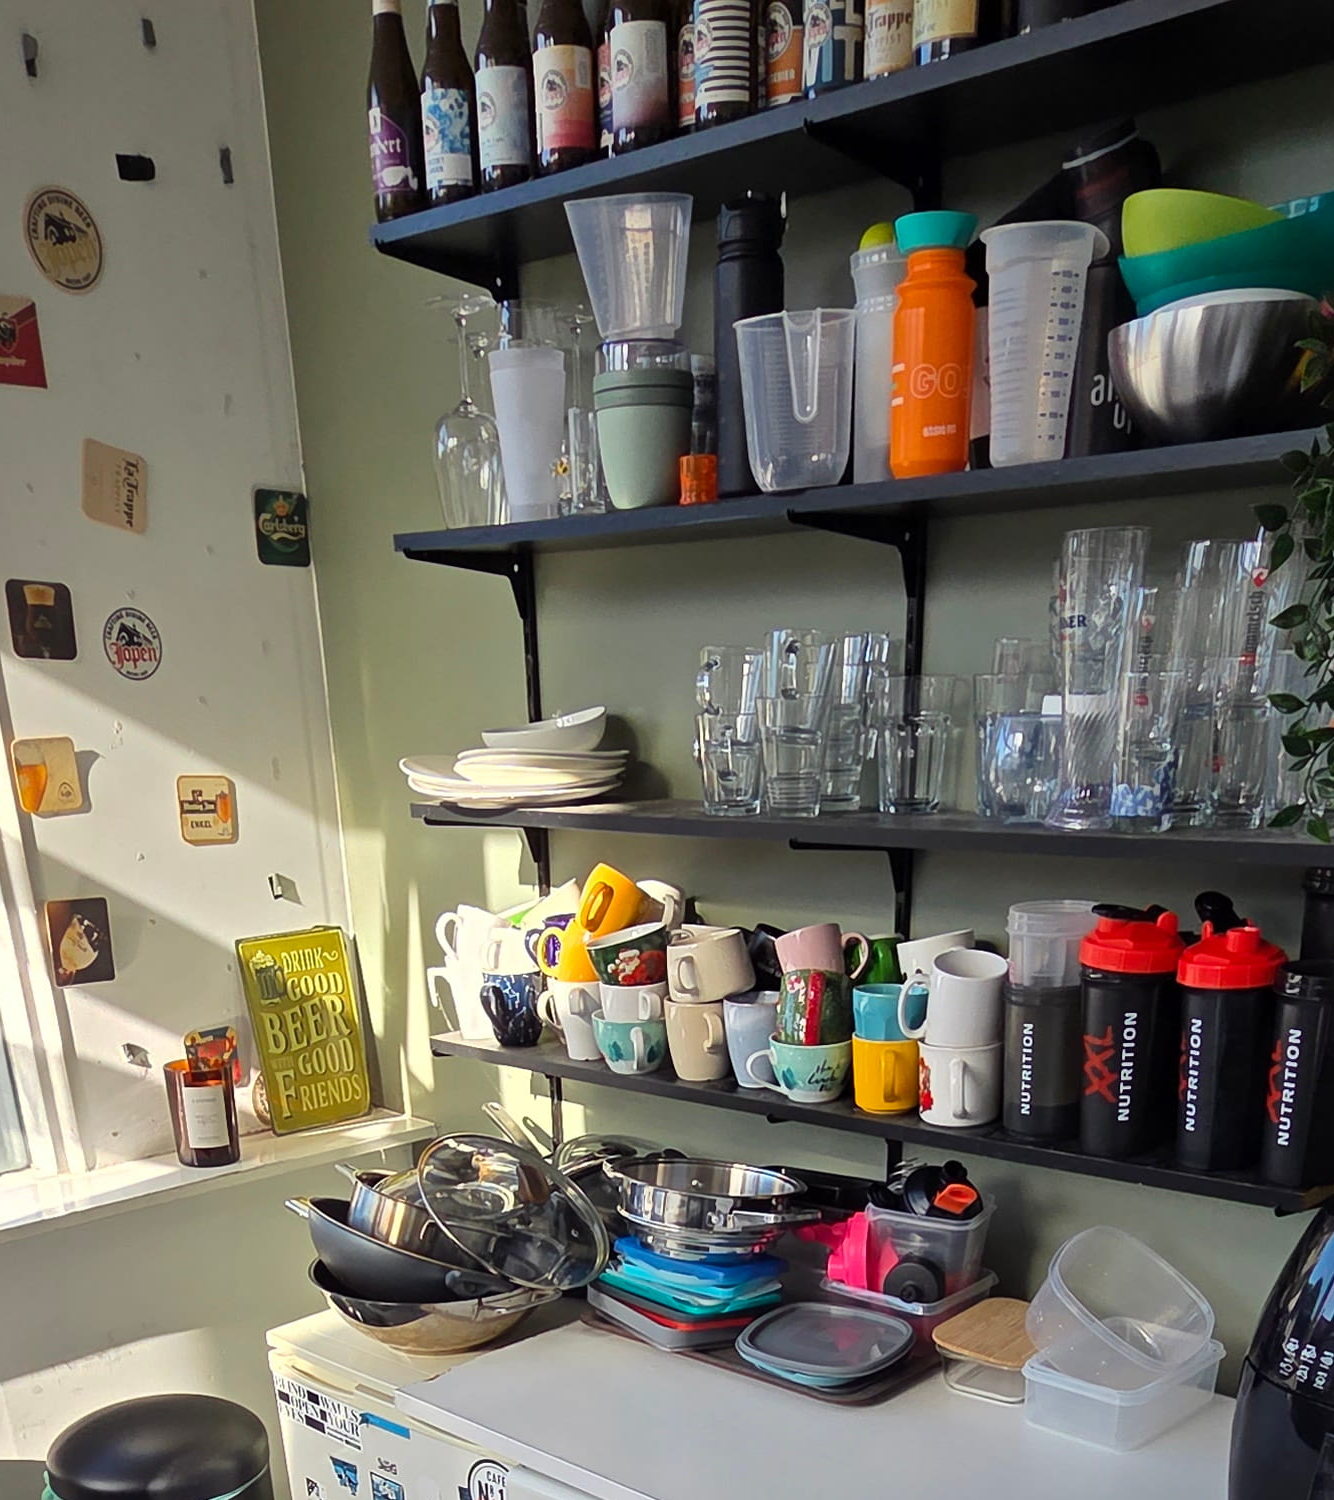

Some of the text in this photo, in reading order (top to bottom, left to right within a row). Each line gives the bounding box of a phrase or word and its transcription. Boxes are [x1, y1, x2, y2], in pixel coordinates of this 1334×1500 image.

[258, 513, 307, 541] Carlsberg
[108, 642, 158, 670] Jopen
[281, 947, 324, 974] DRINK
[287, 971, 345, 1002] GOOD
[261, 995, 352, 1056] BEER
[297, 1037, 355, 1076] GOOD
[1020, 1023, 1034, 1115] NUTRITION
[1083, 1025, 1119, 1104] XXL
[1117, 1012, 1138, 1122] NUTRITION
[1184, 1018, 1203, 1132] NUTRITION
[275, 1068, 363, 1120] FRIENDS
[1277, 1028, 1303, 1147] NUTRITION
[327, 1411, 360, 1437] YOUR
[487, 1471, 507, 1488] CAFE
